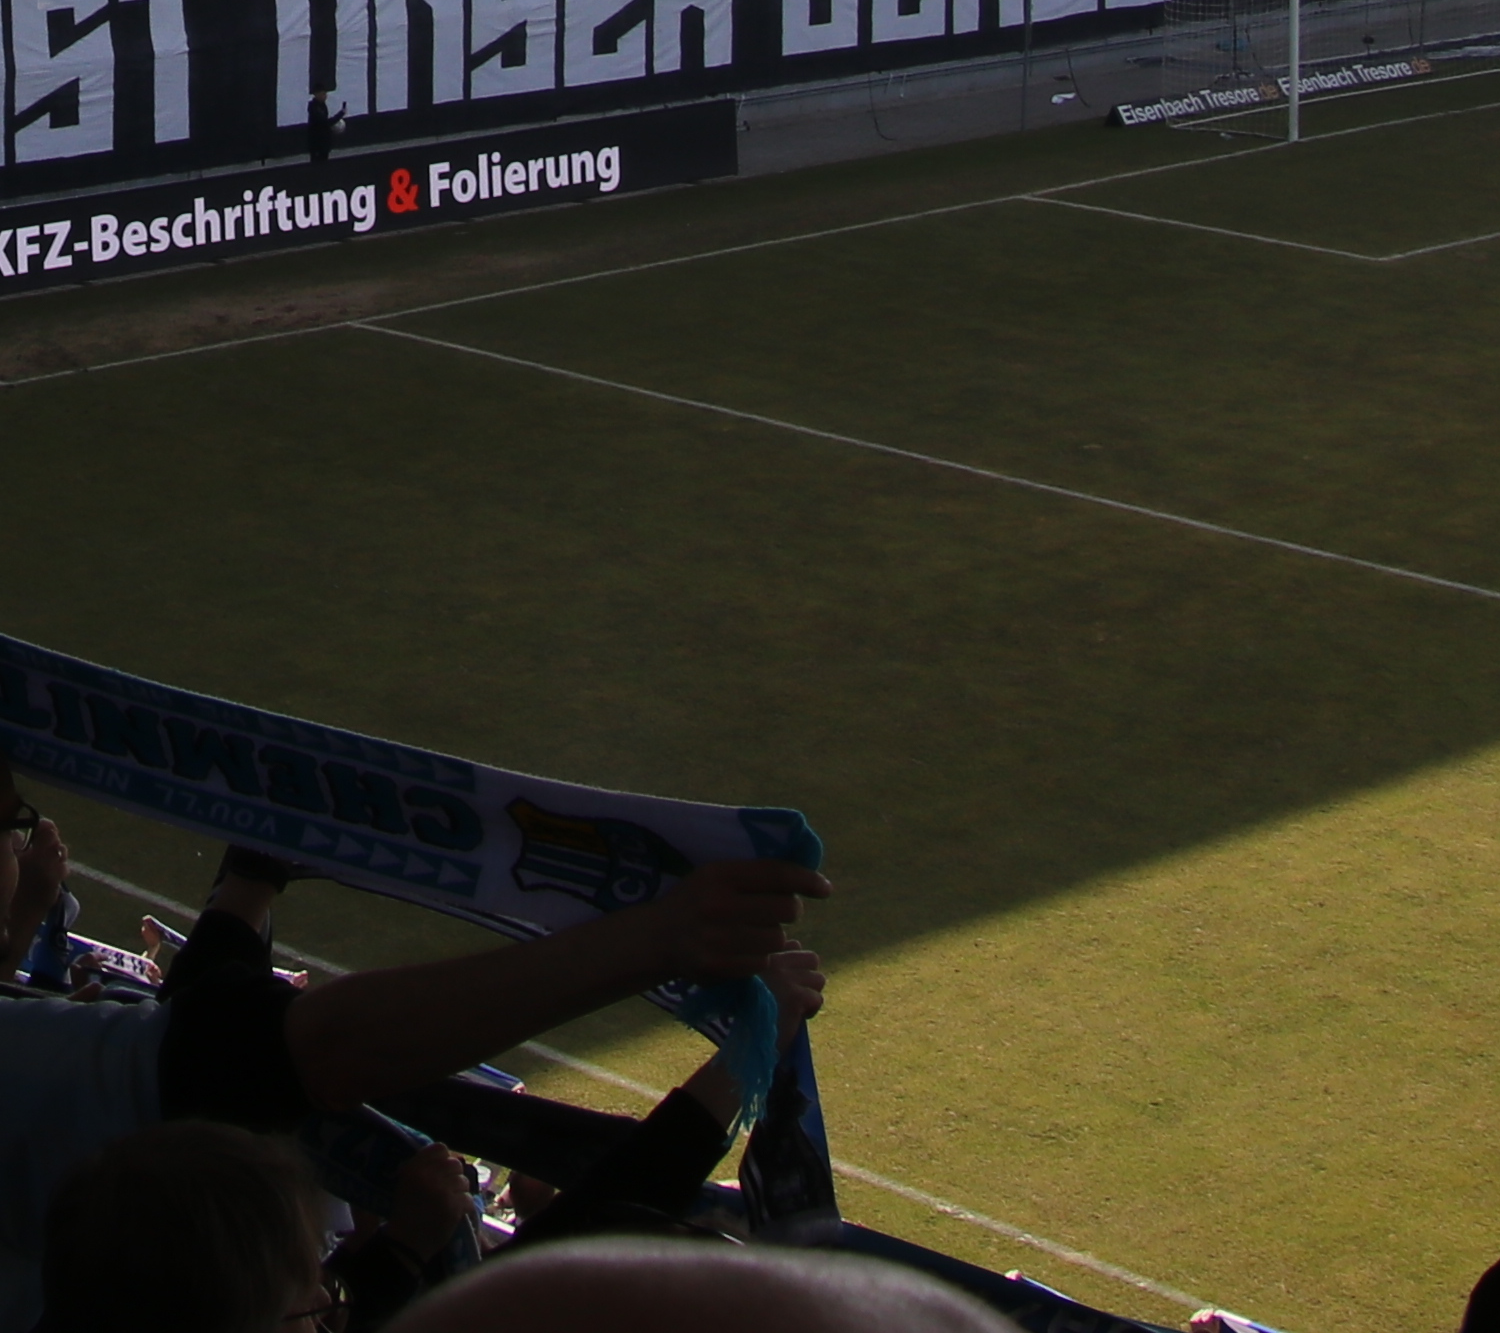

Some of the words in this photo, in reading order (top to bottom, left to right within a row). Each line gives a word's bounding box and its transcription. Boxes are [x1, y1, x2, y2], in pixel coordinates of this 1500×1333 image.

[386, 167, 420, 214] &
[428, 145, 622, 207] Folierung
[12, 739, 131, 794] NEVER
[155, 780, 278, 836] YOU'LL
